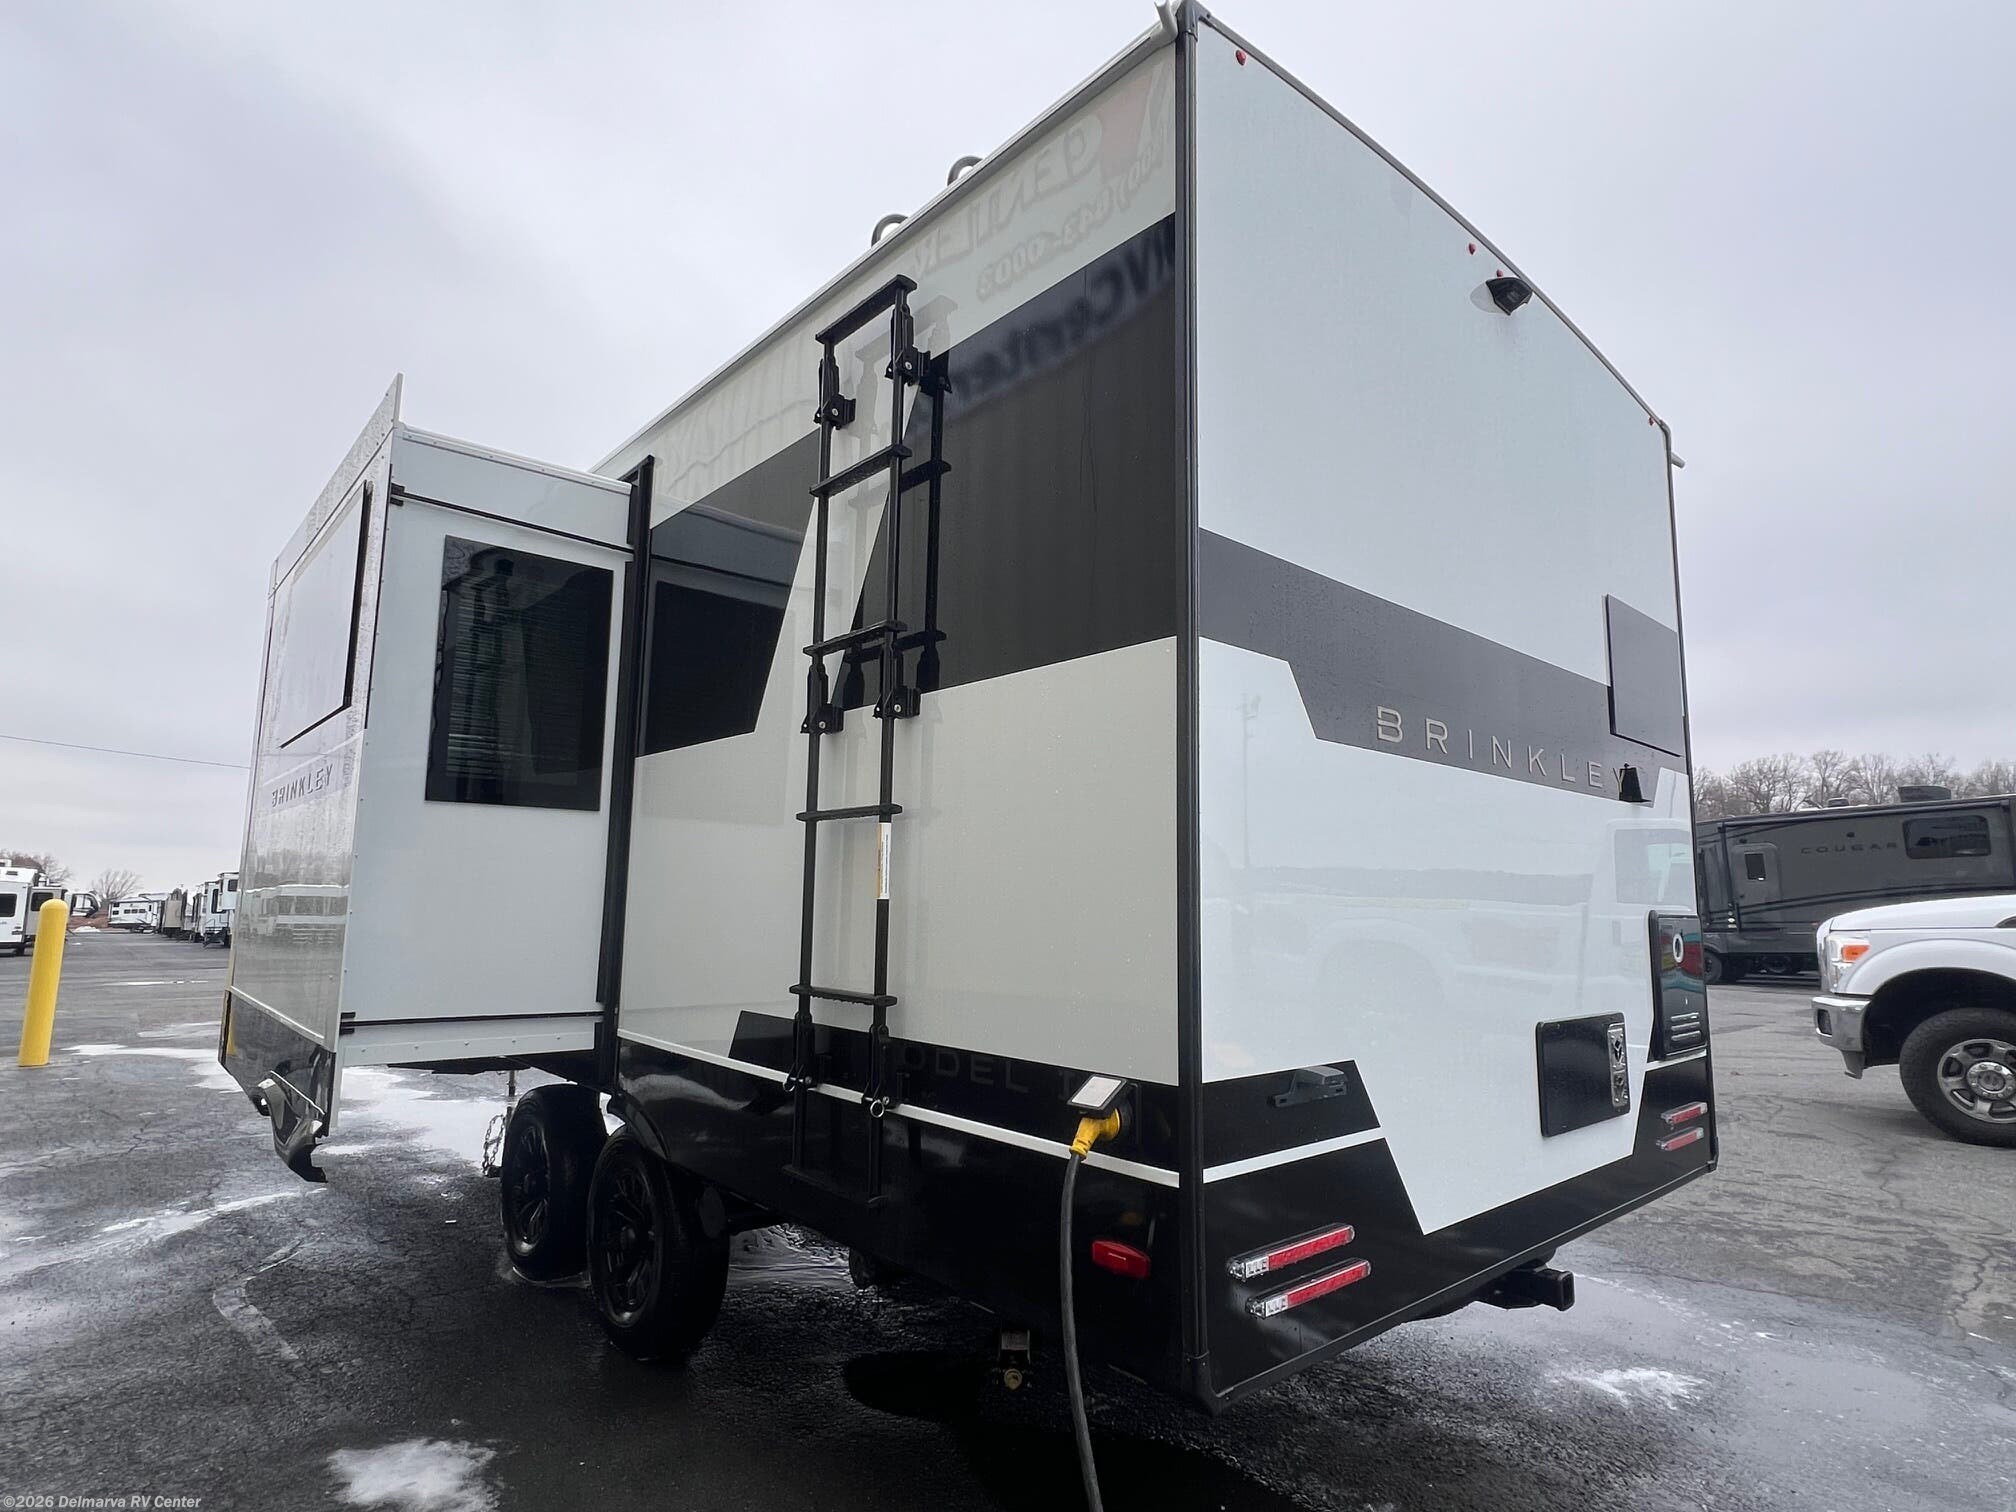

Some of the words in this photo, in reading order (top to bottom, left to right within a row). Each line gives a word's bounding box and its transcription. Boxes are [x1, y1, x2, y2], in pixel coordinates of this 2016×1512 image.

[1375, 705, 1626, 799] BRINKLEY
[271, 762, 334, 808] BRINKLEY
[1800, 842, 1897, 854] COUGAR
[902, 1043, 1030, 1095] ODEL
